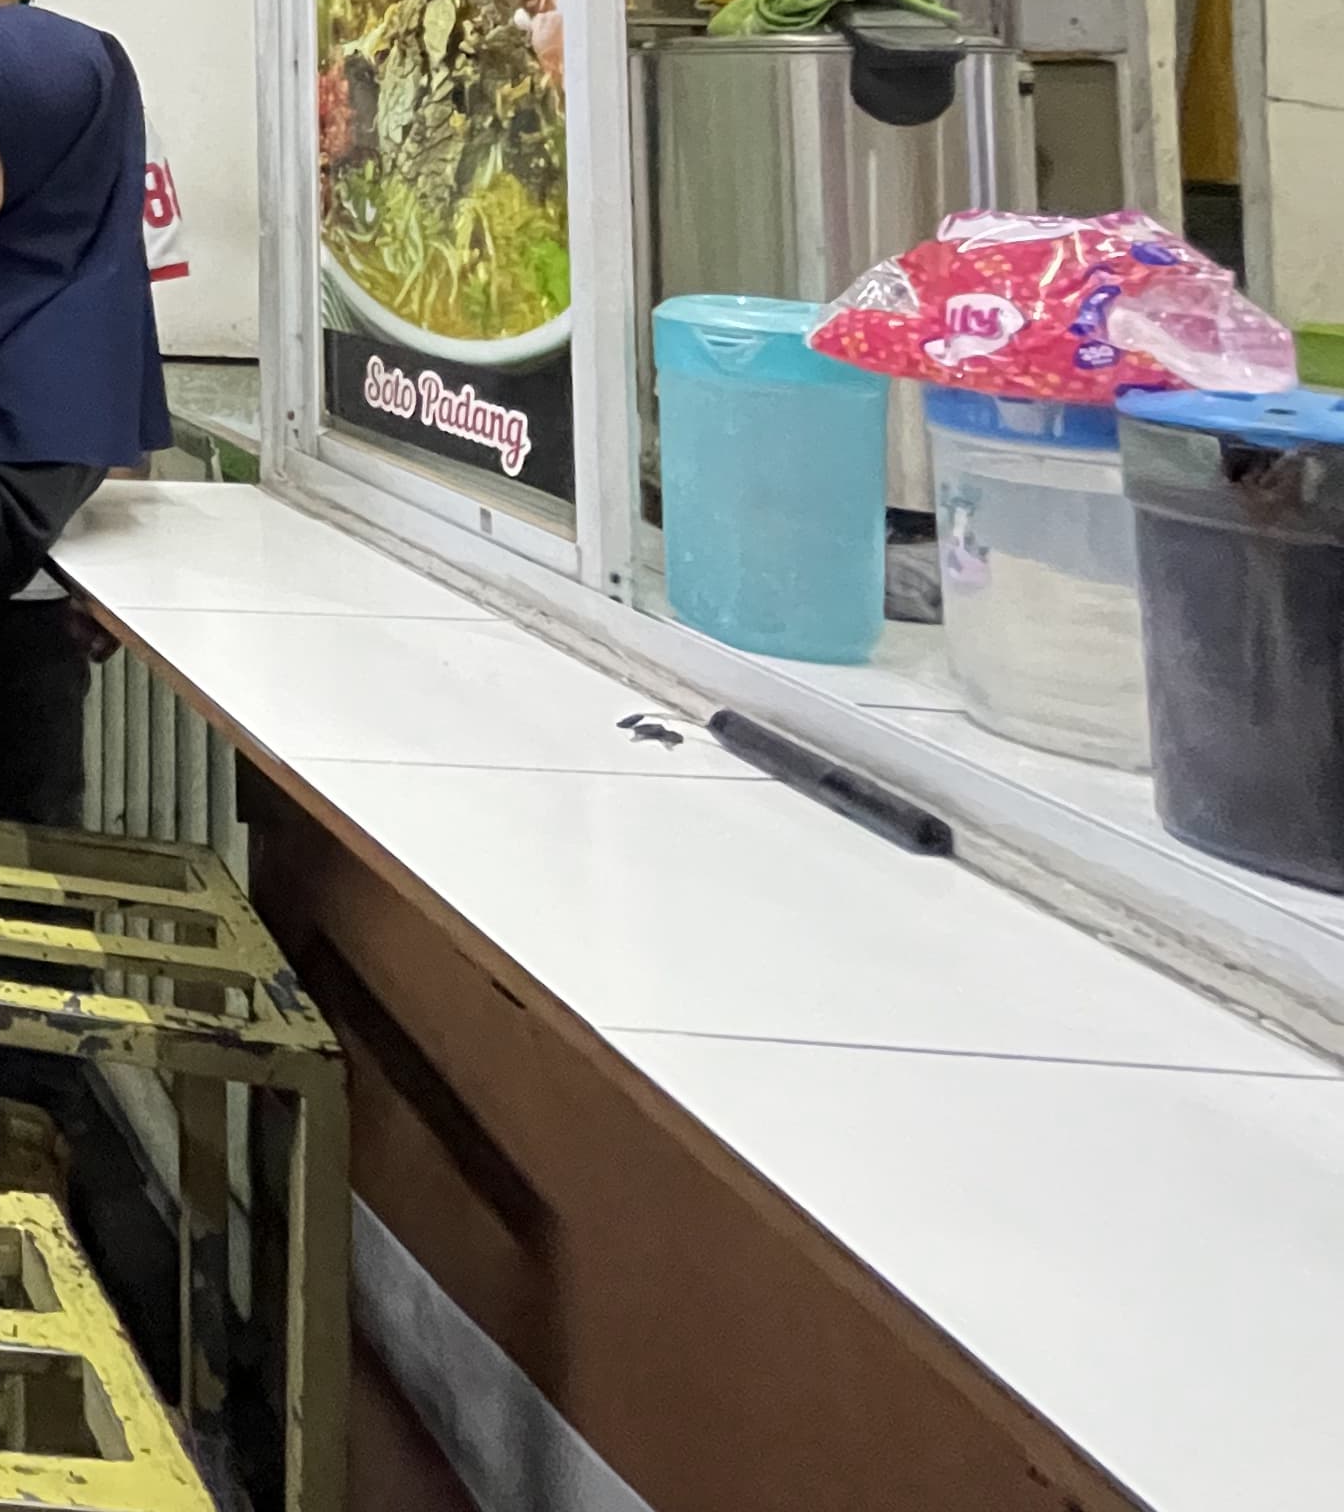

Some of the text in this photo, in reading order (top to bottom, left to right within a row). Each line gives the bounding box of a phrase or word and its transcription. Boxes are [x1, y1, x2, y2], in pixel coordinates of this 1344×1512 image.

[143, 156, 182, 229] 8
[366, 357, 529, 473] Soto Padang
